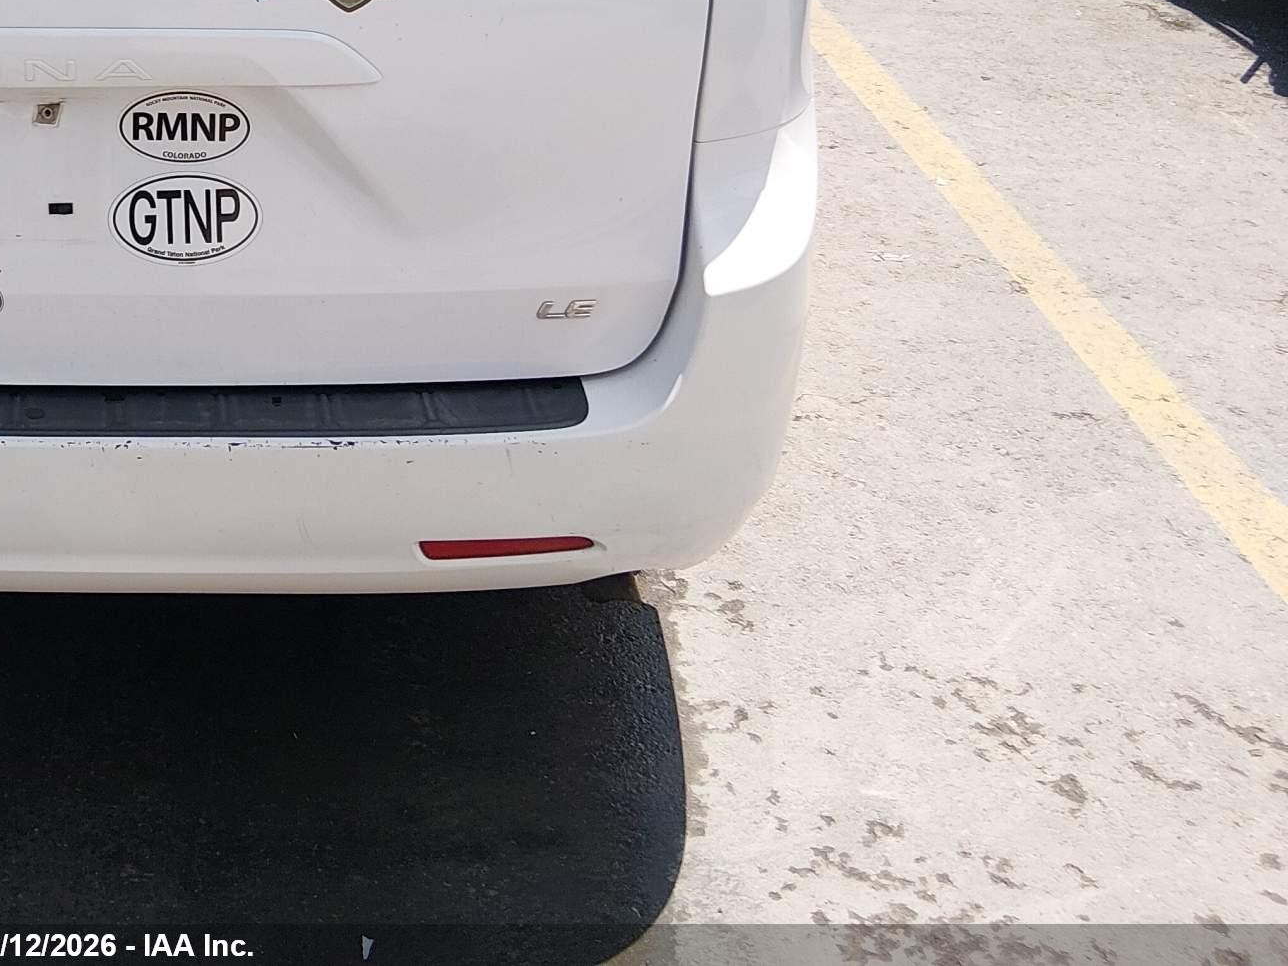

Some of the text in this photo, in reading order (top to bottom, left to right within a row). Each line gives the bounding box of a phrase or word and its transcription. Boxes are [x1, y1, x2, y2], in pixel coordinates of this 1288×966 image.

[132, 112, 241, 142] RMNP
[162, 150, 207, 160] COLORADO
[128, 188, 241, 246] GTNP
[536, 299, 598, 320] LE
